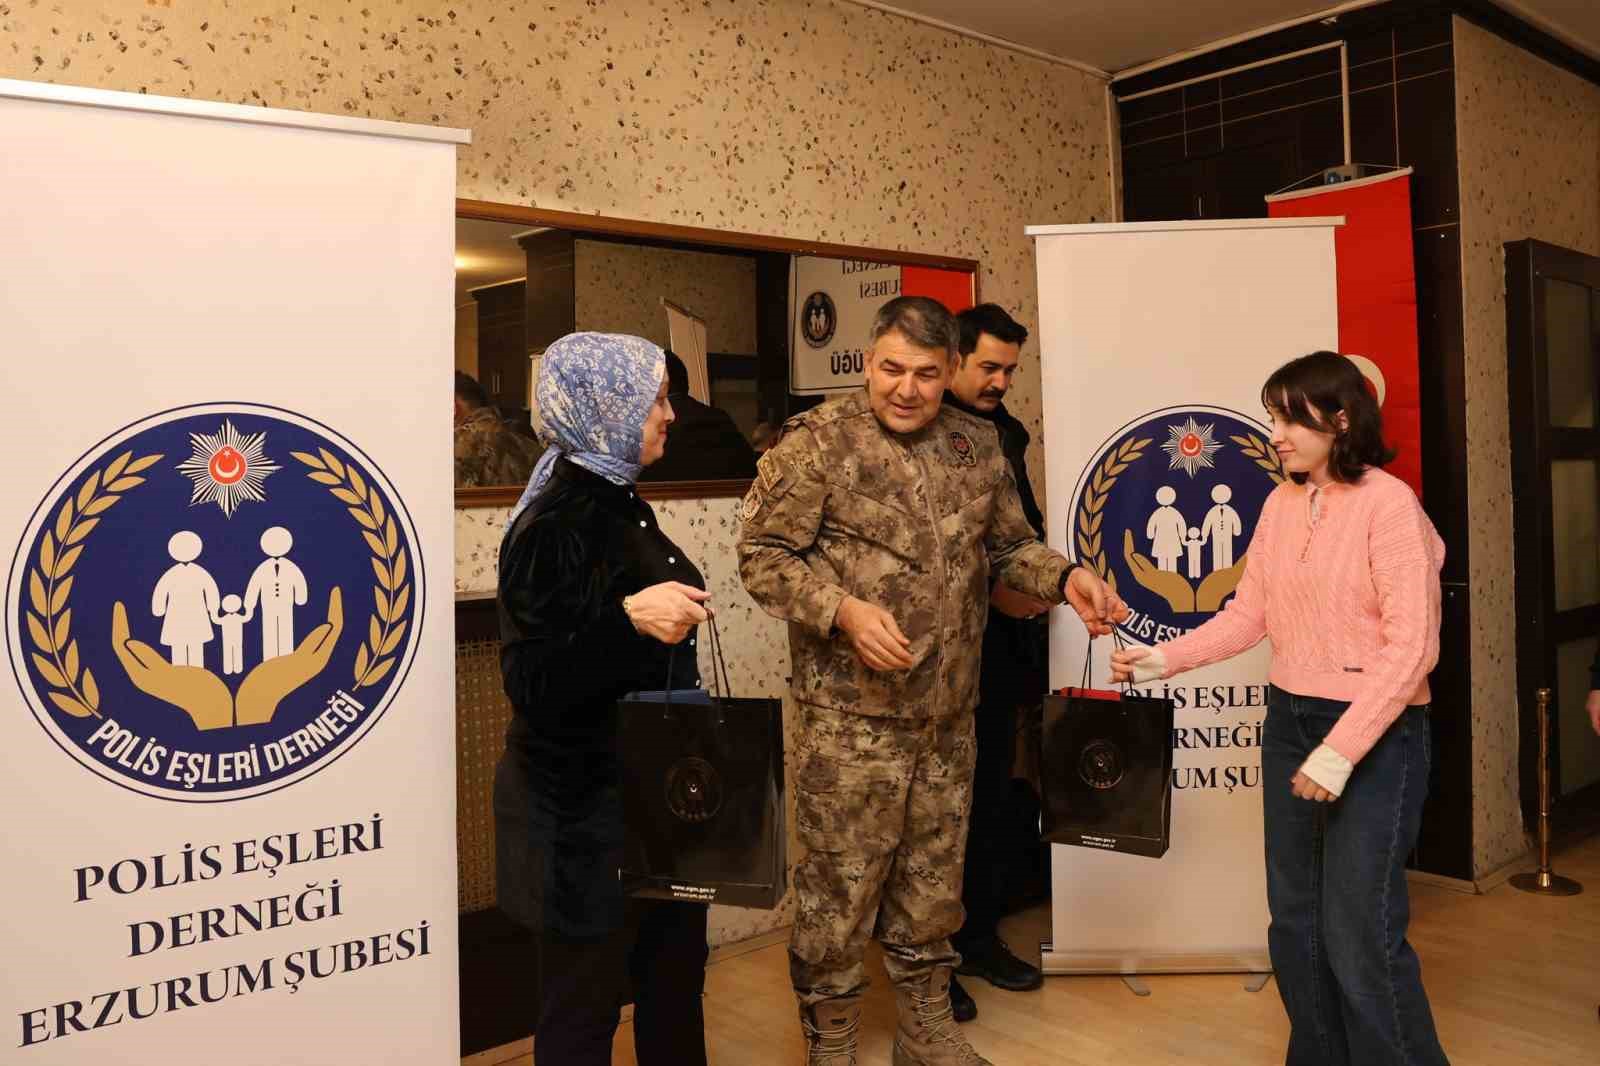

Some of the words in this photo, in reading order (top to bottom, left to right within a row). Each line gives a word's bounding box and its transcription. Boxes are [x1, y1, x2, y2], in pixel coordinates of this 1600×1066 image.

[1121, 608, 1155, 638] OLİS
[86, 718, 168, 776] POLİS
[166, 744, 261, 788] EŞLERİ
[264, 689, 366, 773] DERNEĞİ
[1173, 721, 1264, 749] RNEĞİ
[74, 843, 222, 903] POLİS
[231, 812, 384, 879] EŞLERİ
[127, 879, 342, 958] DERNEĞİ
[18, 957, 275, 1048] ERZURUM
[283, 919, 431, 993] ŞUBESİ
